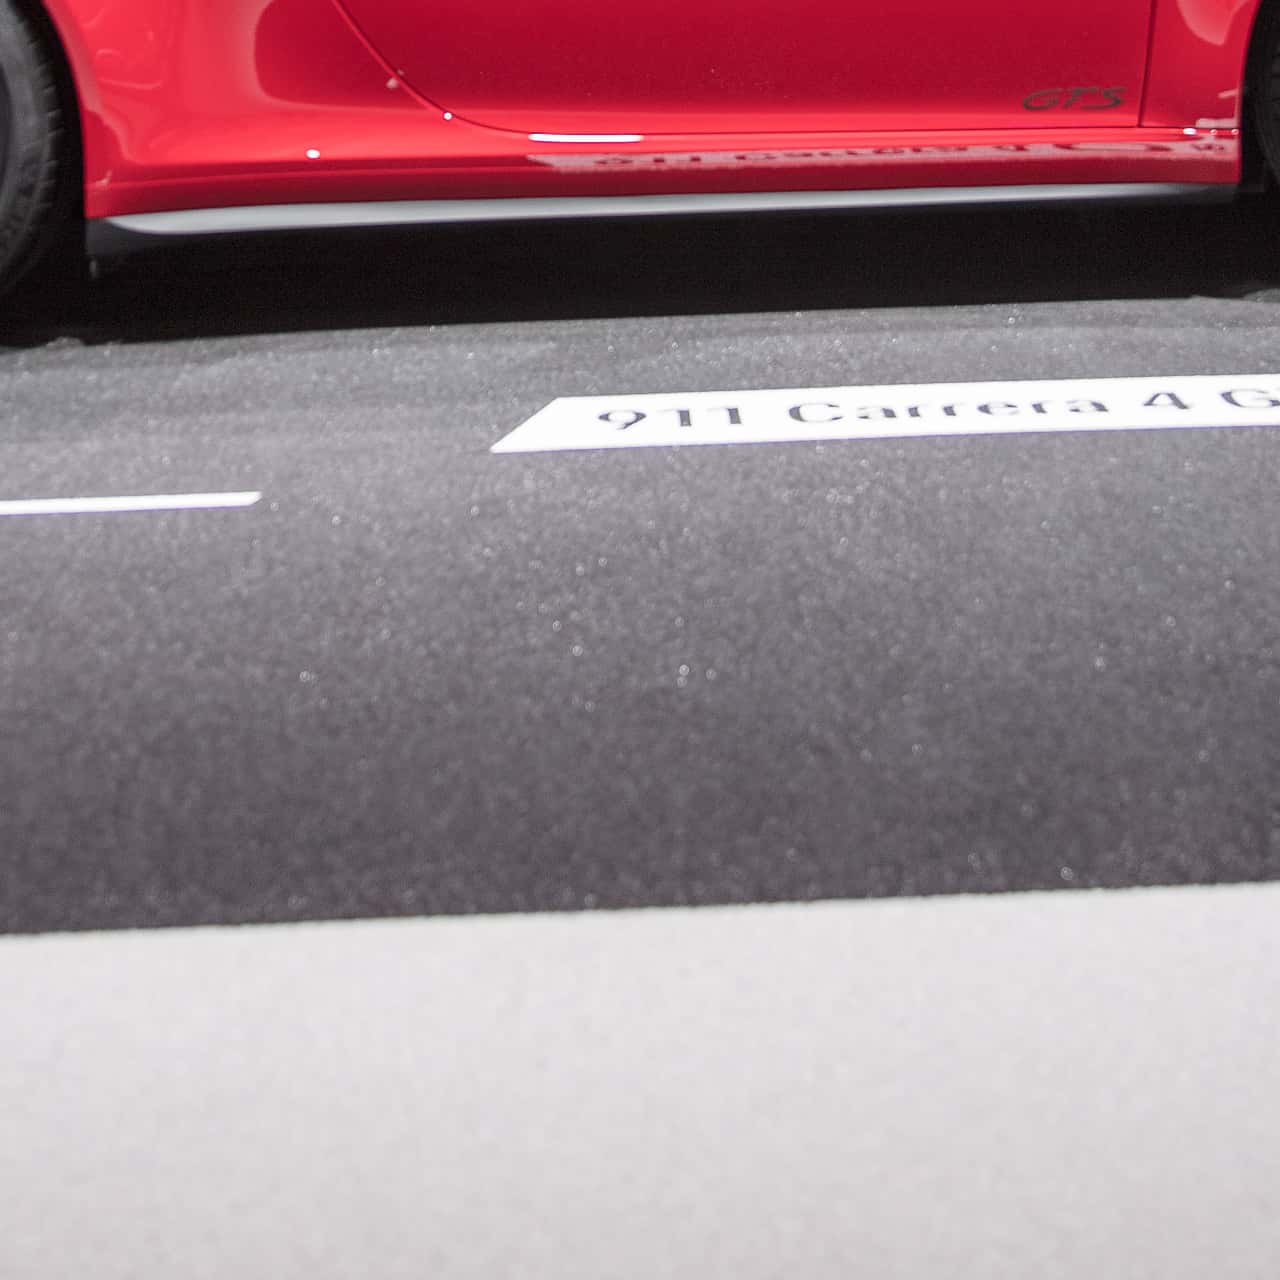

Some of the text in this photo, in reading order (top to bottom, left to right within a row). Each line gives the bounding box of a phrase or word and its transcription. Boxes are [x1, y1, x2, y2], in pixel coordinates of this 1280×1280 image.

[1022, 86, 1127, 111] GTS
[596, 407, 744, 431] 911
[787, 400, 1111, 424] Carrera
[1141, 391, 1192, 412] 4
